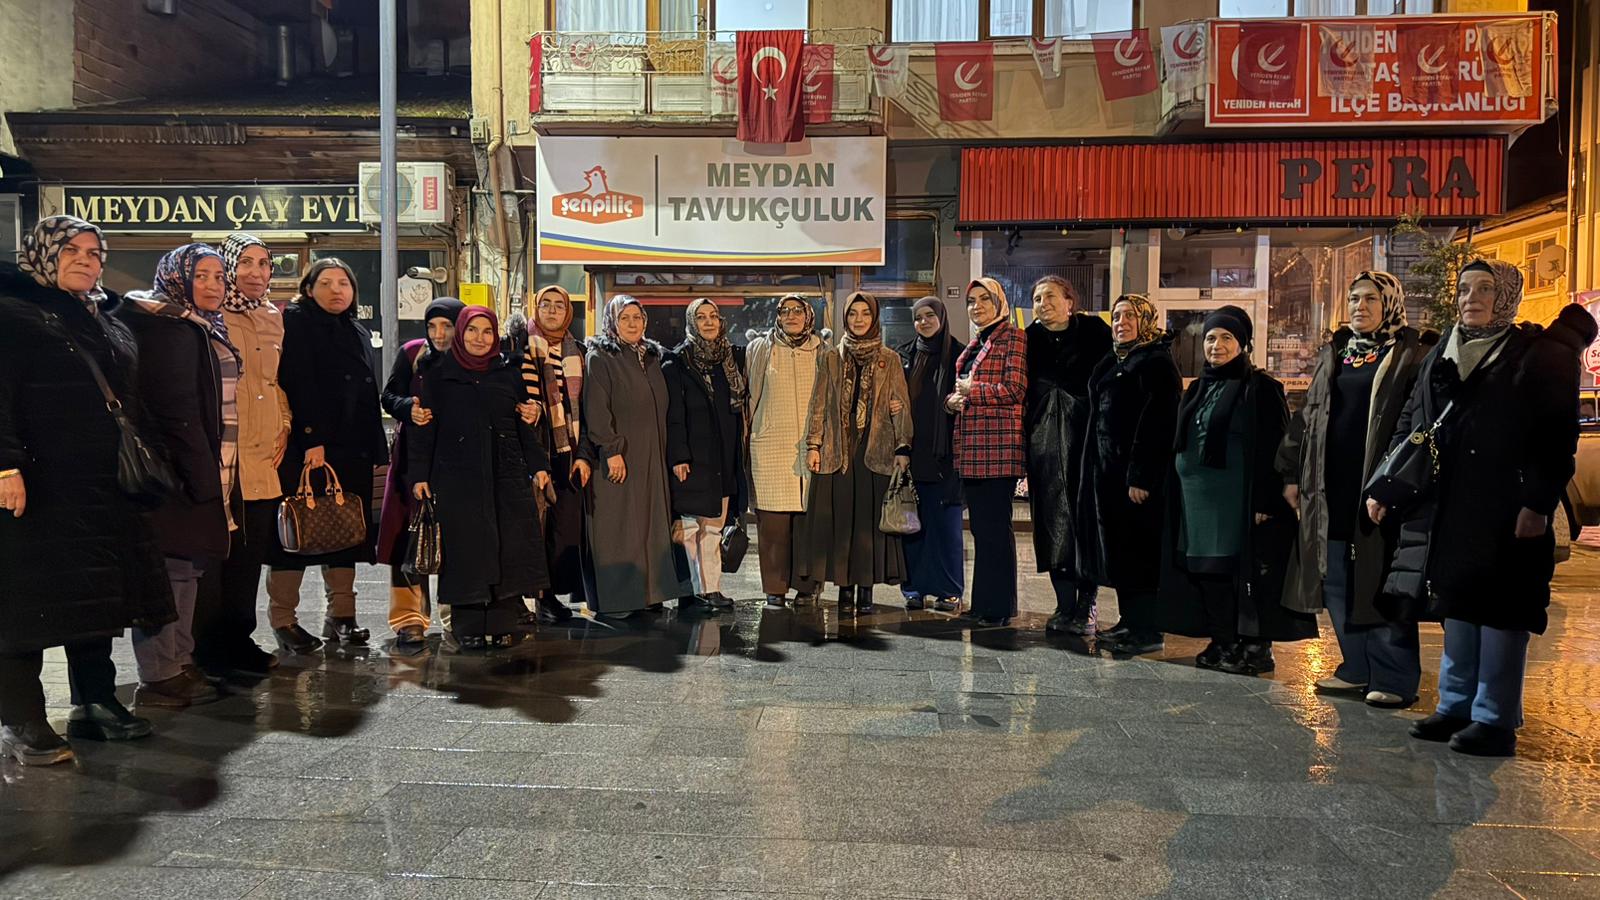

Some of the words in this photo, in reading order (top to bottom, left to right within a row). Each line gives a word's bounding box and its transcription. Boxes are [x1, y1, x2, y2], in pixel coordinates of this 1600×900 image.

[707, 162, 835, 188] MEYDAN
[1279, 155, 1481, 200] PERA
[71, 195, 218, 224] MEYDAN
[225, 194, 293, 230] ÇAY
[301, 187, 358, 222] EVİ
[427, 177, 435, 209] VESTEL
[561, 194, 633, 217] şenpiliç
[668, 196, 874, 229] TAVUKÇULUK
